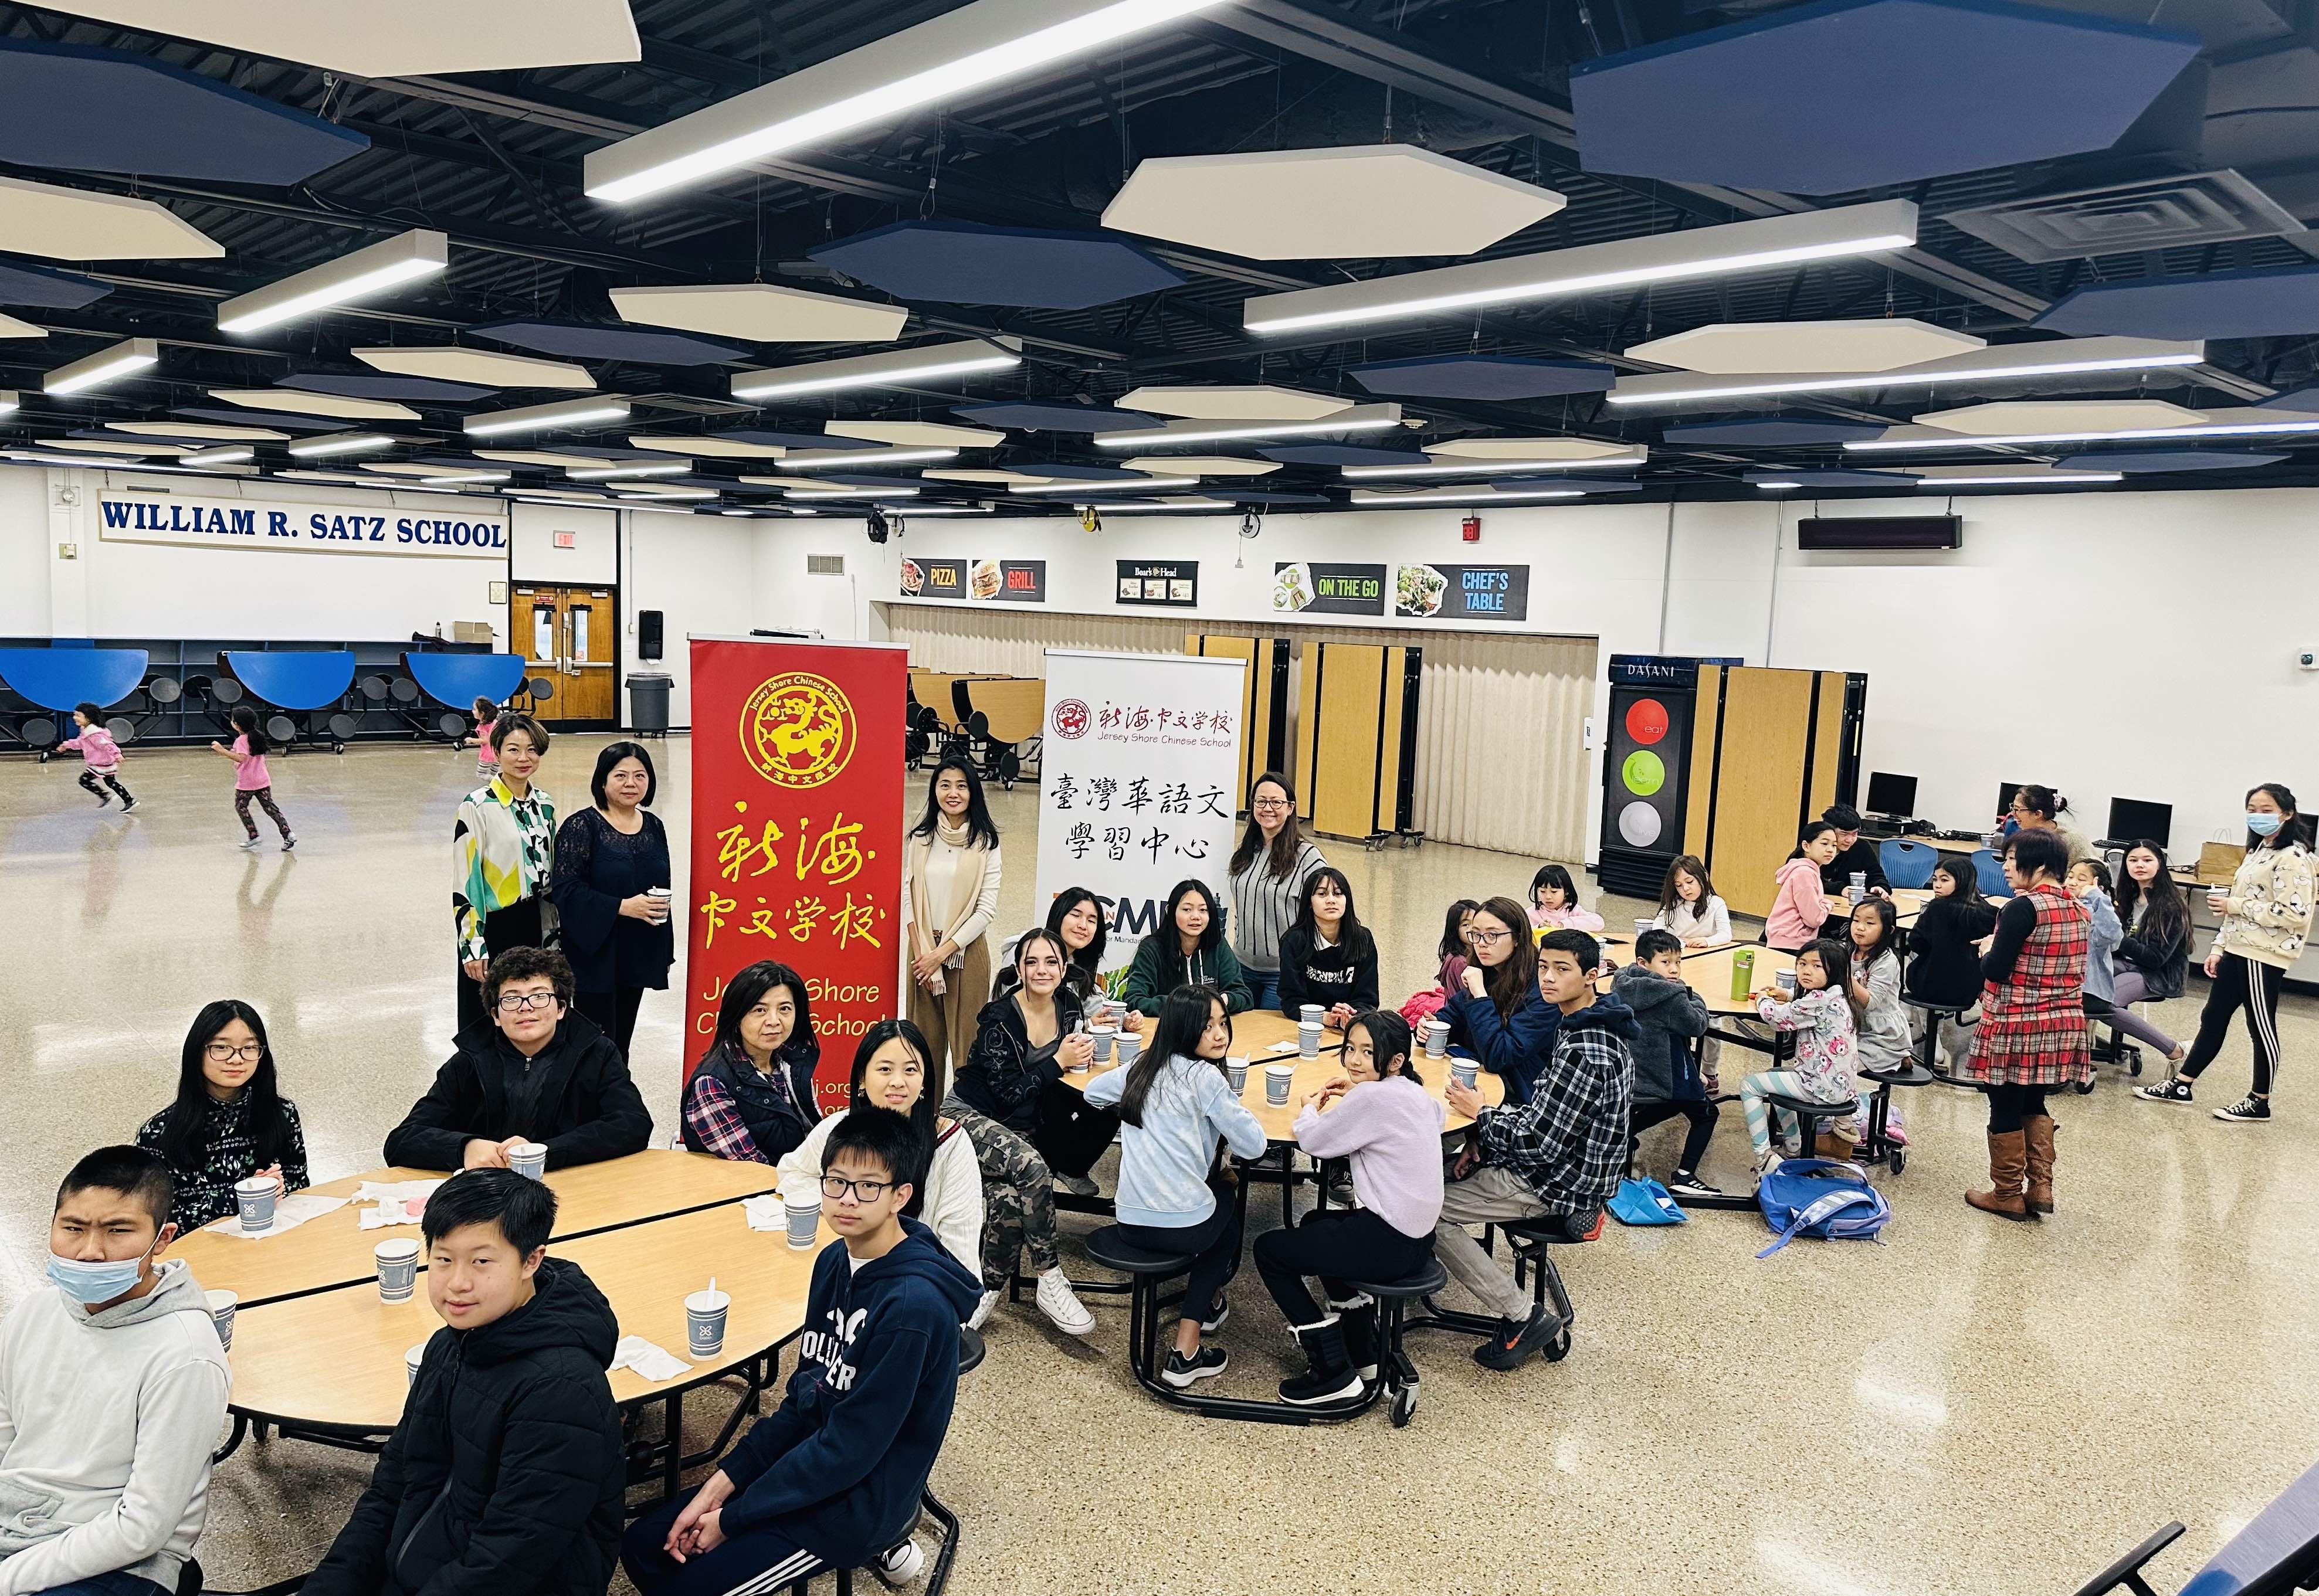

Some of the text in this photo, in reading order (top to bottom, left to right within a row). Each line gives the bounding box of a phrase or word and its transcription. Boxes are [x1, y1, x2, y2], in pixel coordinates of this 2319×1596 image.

[101, 501, 507, 548] WILLIAM R. SATZ SCHOOL
[558, 533, 574, 546] EXIT
[930, 568, 957, 586] PIZZA
[1008, 571, 1036, 590] GRILL
[1160, 568, 1177, 577] Head
[1462, 572, 1508, 590] CHEF'S
[1318, 579, 1379, 597] ON THE GO
[1465, 593, 1504, 611] TABLE
[1628, 662, 1674, 678] DASANI
[750, 675, 848, 714] Jersey Shore Chinese School
[1097, 731, 1232, 748] Jersey Shore Chinese School
[1050, 772, 1229, 819] 臺灣華語文
[1065, 821, 1210, 865] 學習中心
[807, 977, 880, 1003] Shore
